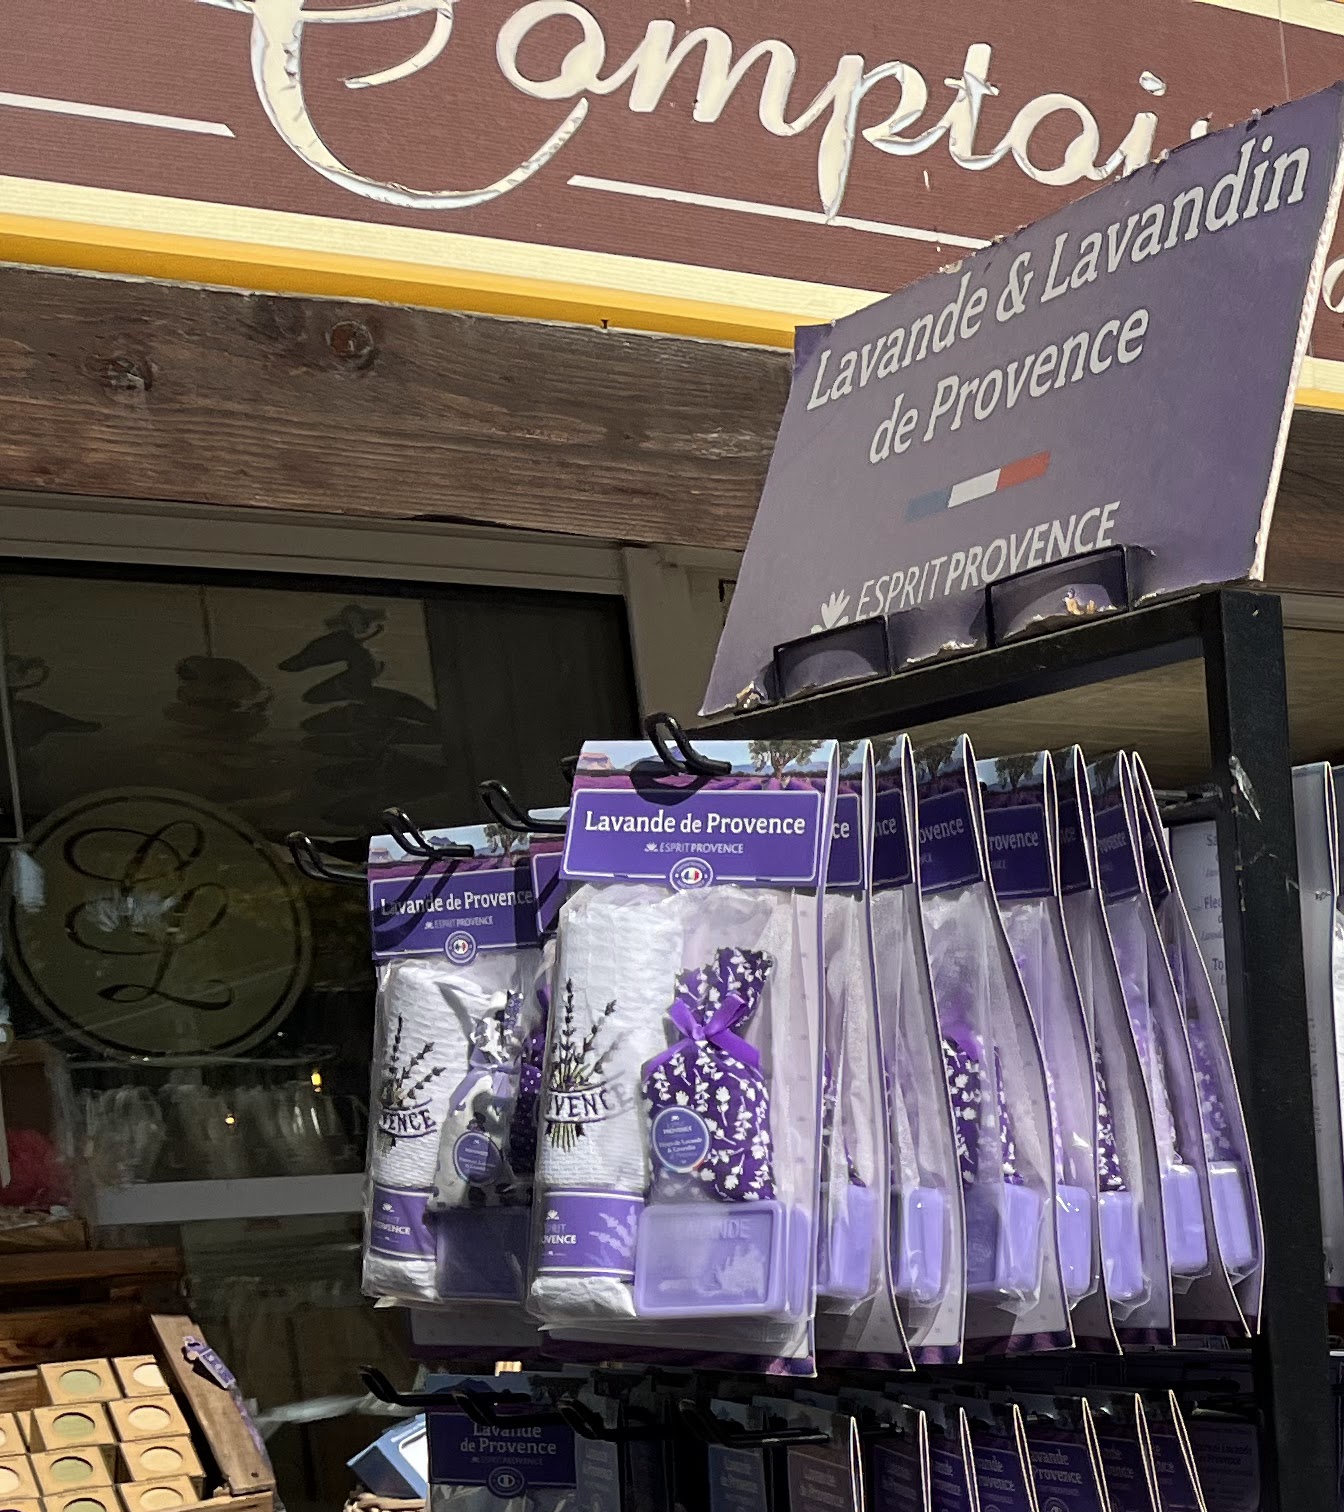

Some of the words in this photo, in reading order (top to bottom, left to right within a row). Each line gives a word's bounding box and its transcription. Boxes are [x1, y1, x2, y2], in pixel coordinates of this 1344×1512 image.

[200, 0, 1213, 223] Comptoi
[806, 274, 989, 411] Lavande
[996, 255, 1031, 325] &
[1040, 137, 1311, 302] Lavandin
[868, 397, 914, 464] de
[924, 306, 1150, 443] Provence
[585, 809, 676, 833] Lavande
[680, 813, 702, 833] de
[706, 813, 806, 835] Provence
[919, 816, 965, 845] ovence
[988, 830, 1040, 851] rovence
[380, 892, 444, 916] Lavande
[446, 893, 463, 911] de
[464, 890, 533, 910] Provence
[551, 1083, 634, 1118] VENCE
[460, 1437, 476, 1452] de
[478, 1437, 557, 1455] Provence
